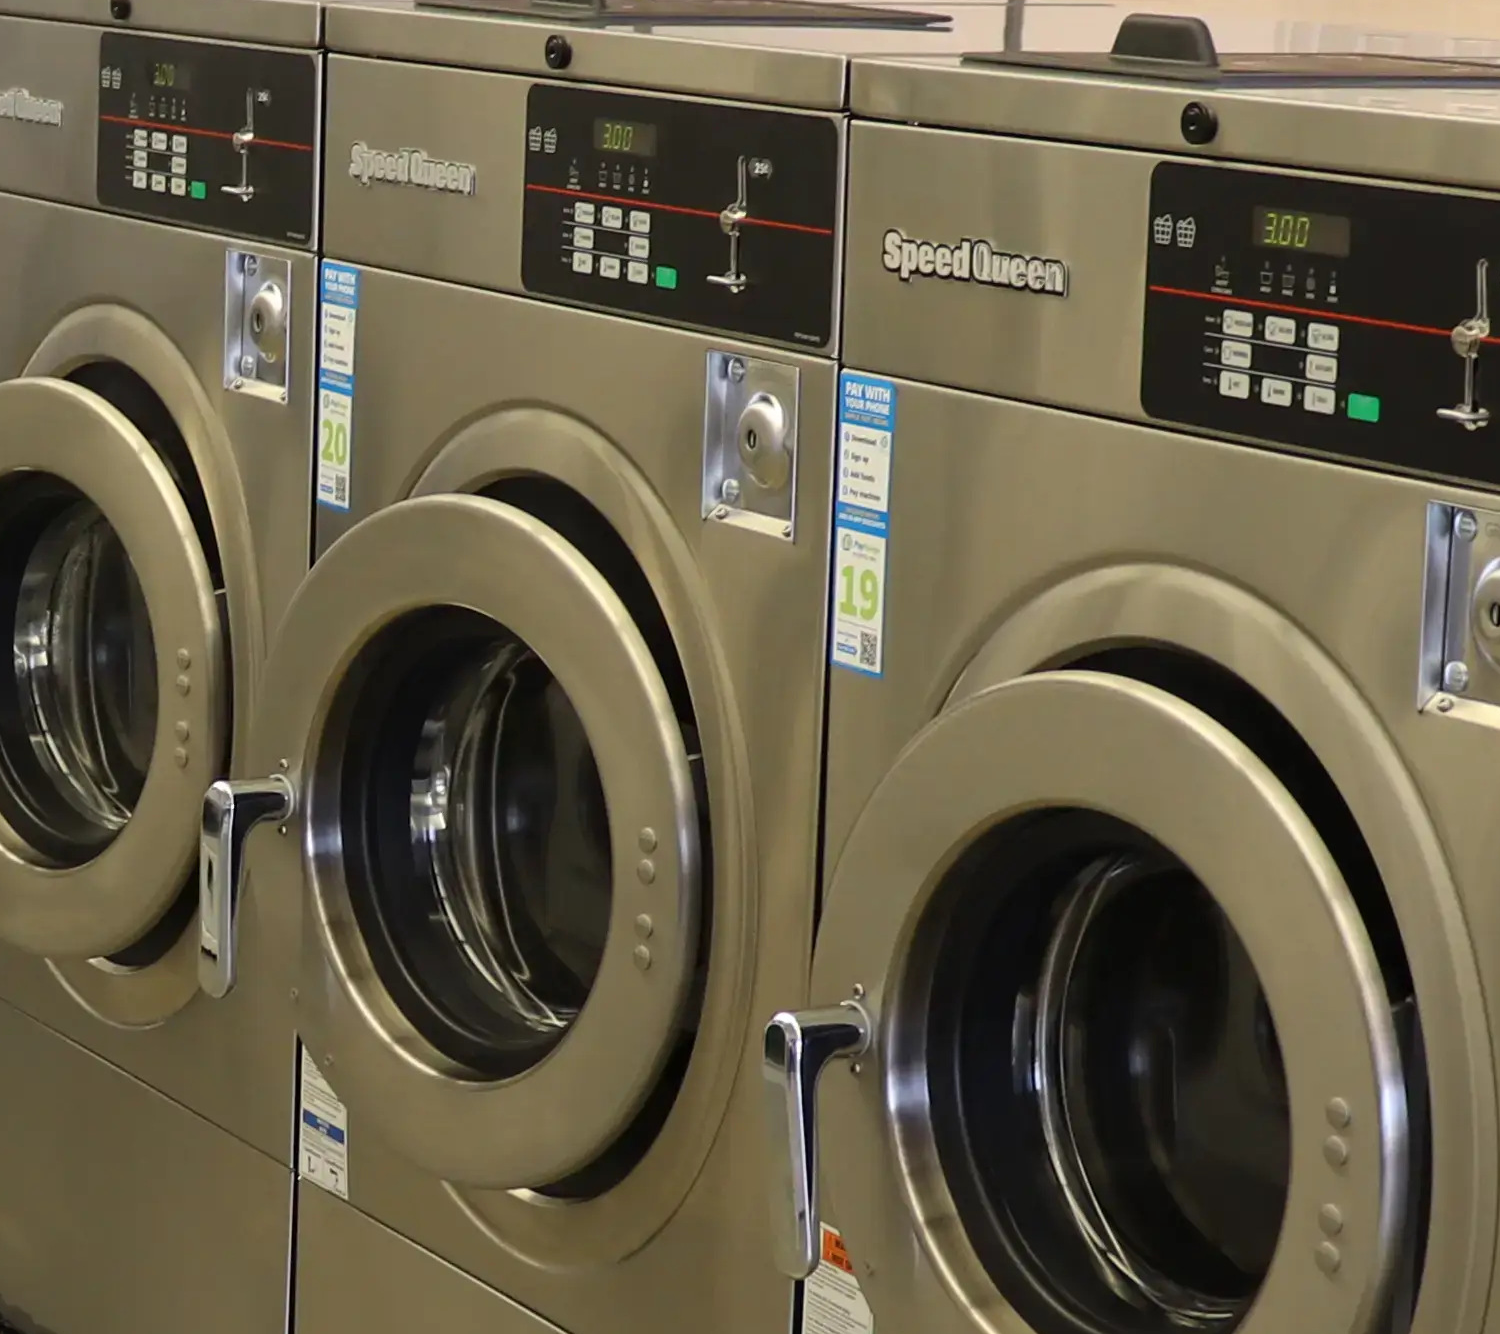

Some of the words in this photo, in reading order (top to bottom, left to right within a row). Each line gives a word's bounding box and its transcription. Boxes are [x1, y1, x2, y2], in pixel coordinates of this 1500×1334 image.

[1264, 213, 1311, 248] 3.00
[882, 228, 972, 281] Speed
[972, 239, 1069, 298] Queen
[845, 381, 865, 398] PAY
[864, 384, 891, 403] WITH
[321, 418, 348, 465] 20
[840, 565, 879, 621] 19
